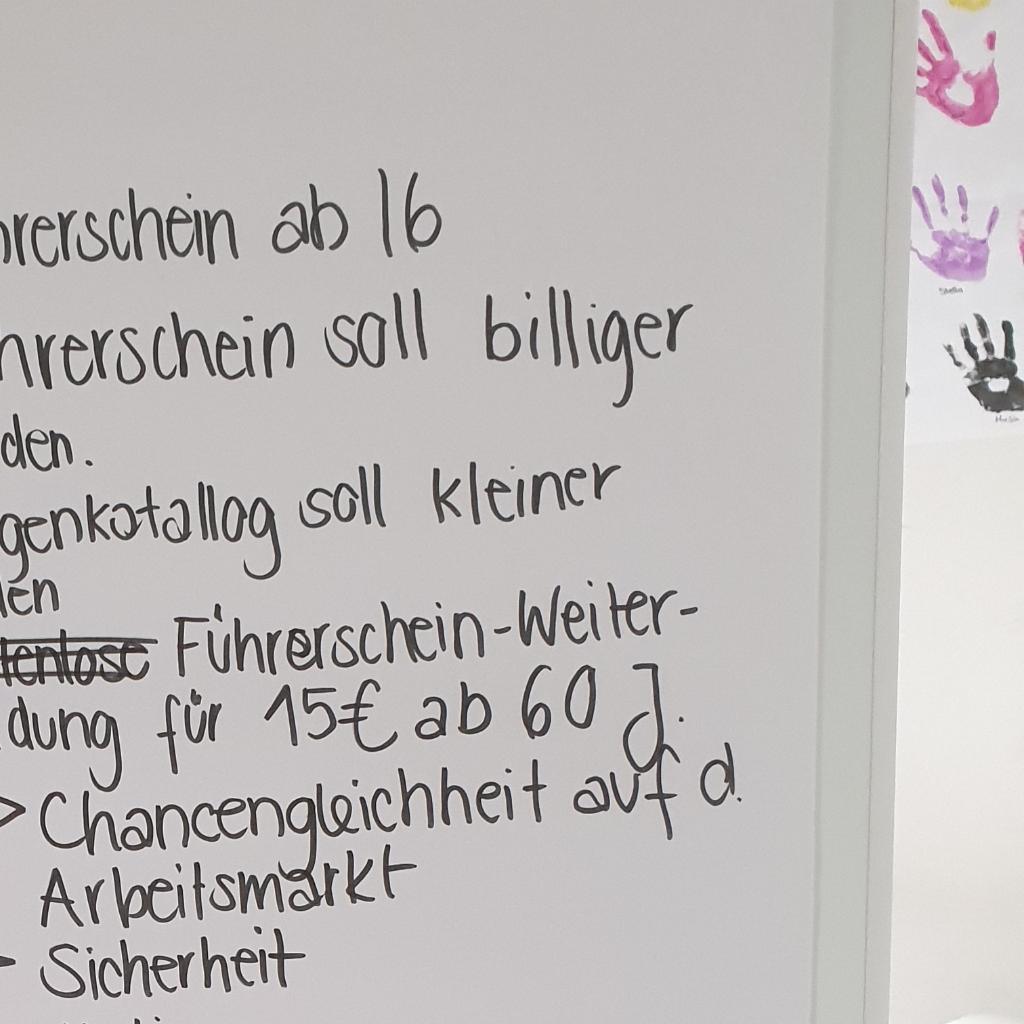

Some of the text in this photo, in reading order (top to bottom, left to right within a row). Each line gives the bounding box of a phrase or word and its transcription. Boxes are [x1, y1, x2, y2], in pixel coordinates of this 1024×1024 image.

[271, 184, 348, 255] ab
[378, 168, 442, 258] 16
[324, 288, 429, 368] soll
[484, 286, 694, 409] billiger
[298, 462, 387, 530] soll
[431, 460, 622, 525] kleiner
[156, 689, 225, 774] für
[264, 680, 398, 753] 15€
[414, 681, 493, 738] ab
[521, 663, 597, 739] 60
[39, 758, 547, 881] Chancengleichheit
[574, 744, 679, 840] auf
[39, 845, 417, 928] Arbeitsmarkt
[39, 928, 306, 1002] Sicherheit
